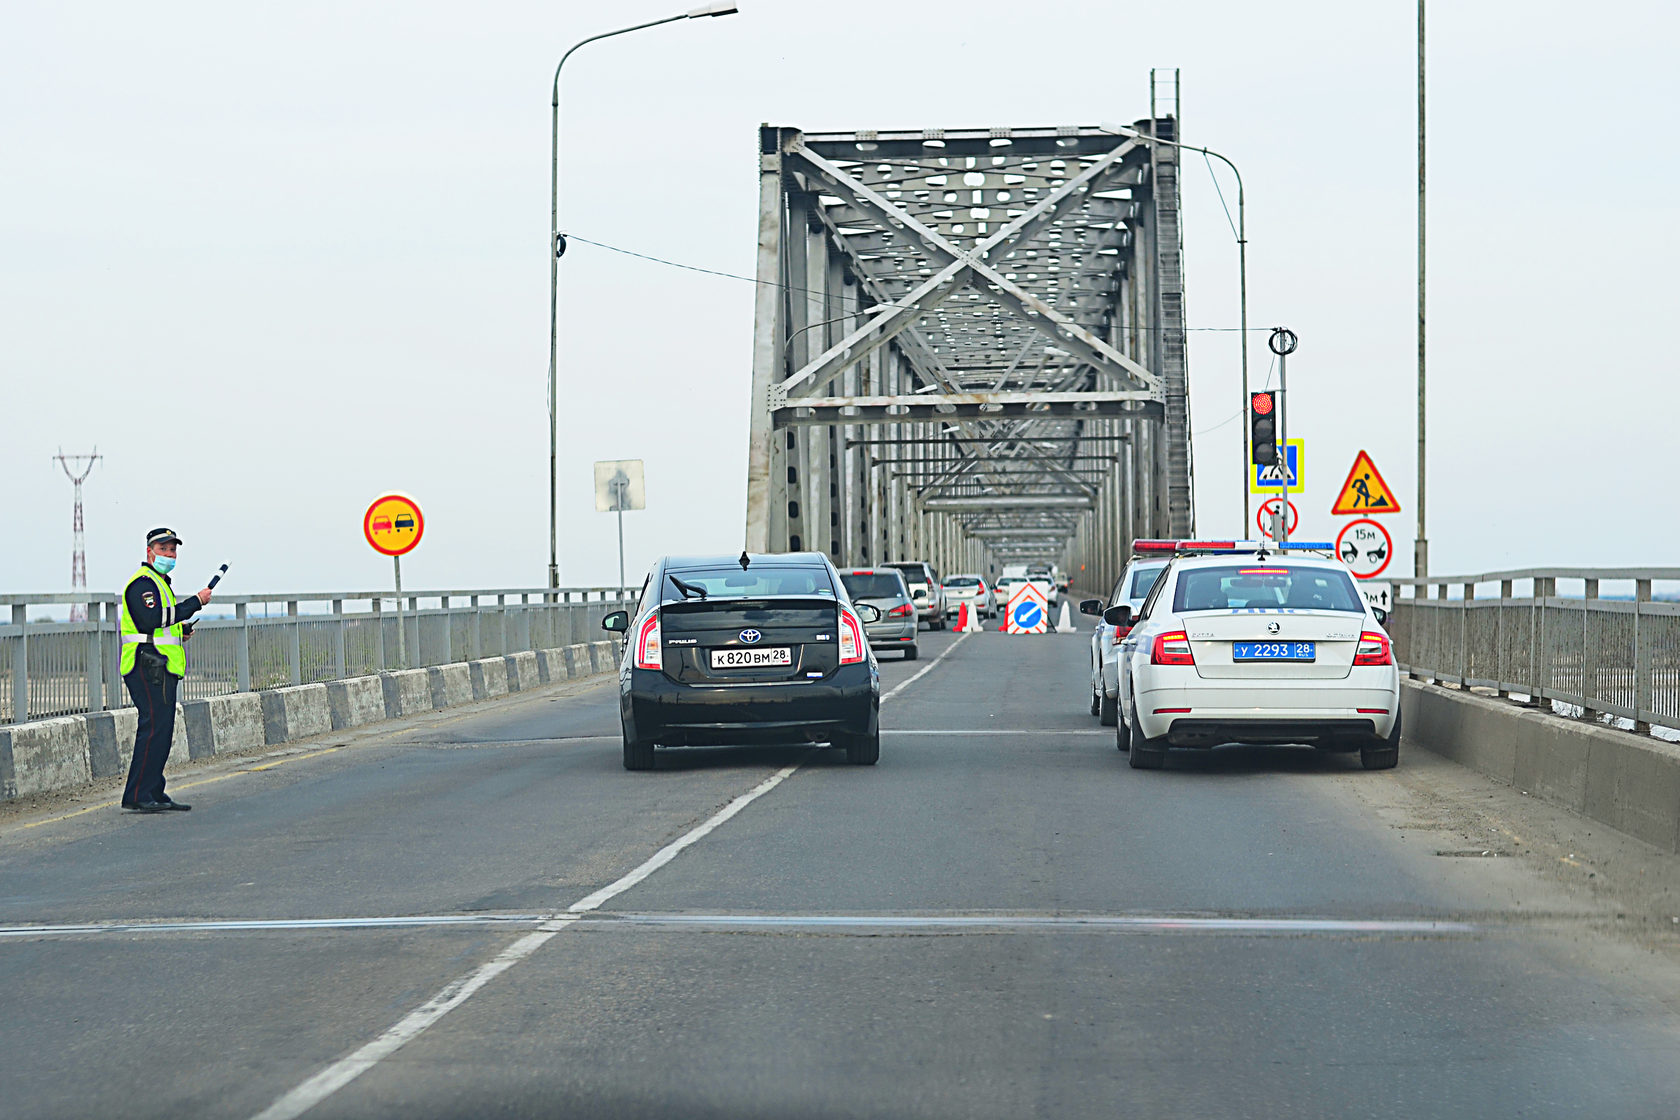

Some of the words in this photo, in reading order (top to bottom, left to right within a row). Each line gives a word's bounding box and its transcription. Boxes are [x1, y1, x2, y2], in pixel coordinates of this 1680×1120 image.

[773, 649, 786, 660] 28
[1254, 643, 1289, 657] 2293
[1296, 643, 1310, 653] 28
